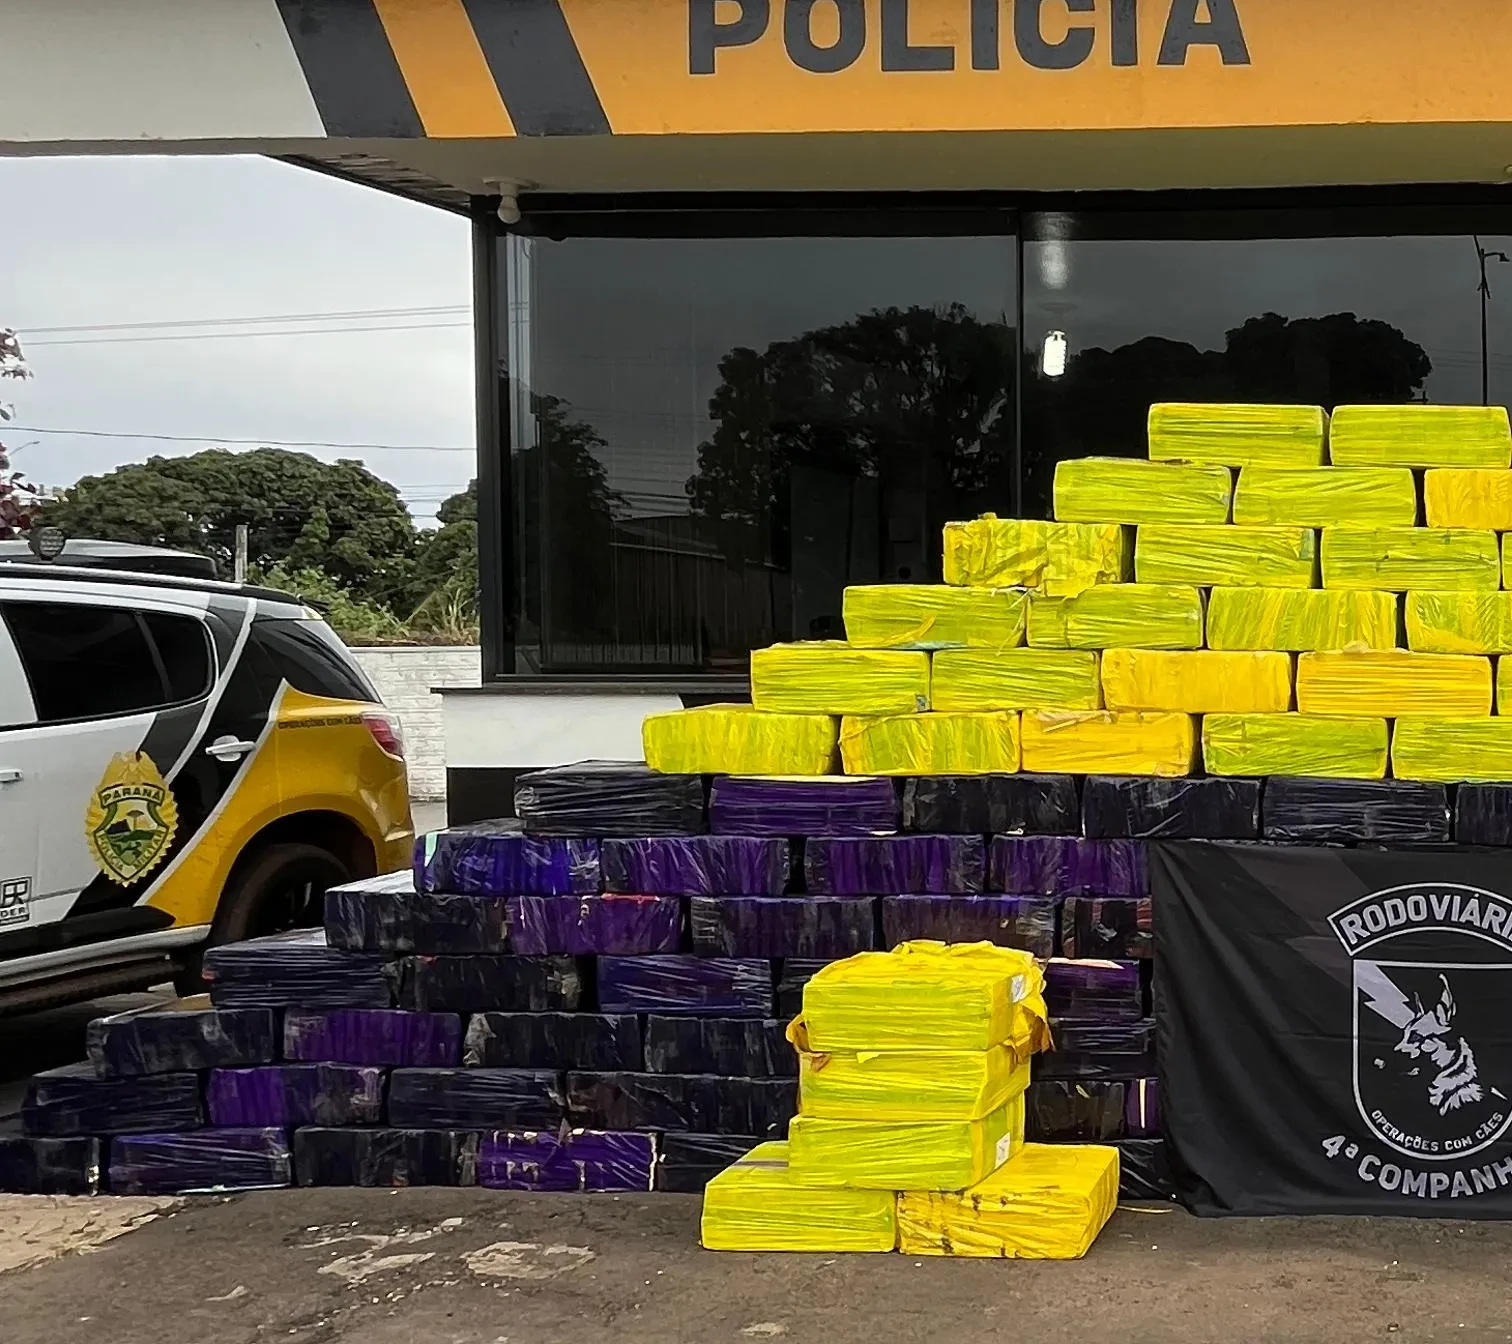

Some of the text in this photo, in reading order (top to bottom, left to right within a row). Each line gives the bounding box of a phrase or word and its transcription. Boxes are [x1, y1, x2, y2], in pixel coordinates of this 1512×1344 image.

[1371, 1110, 1503, 1151] OPERAÇÕES COM CÃES
